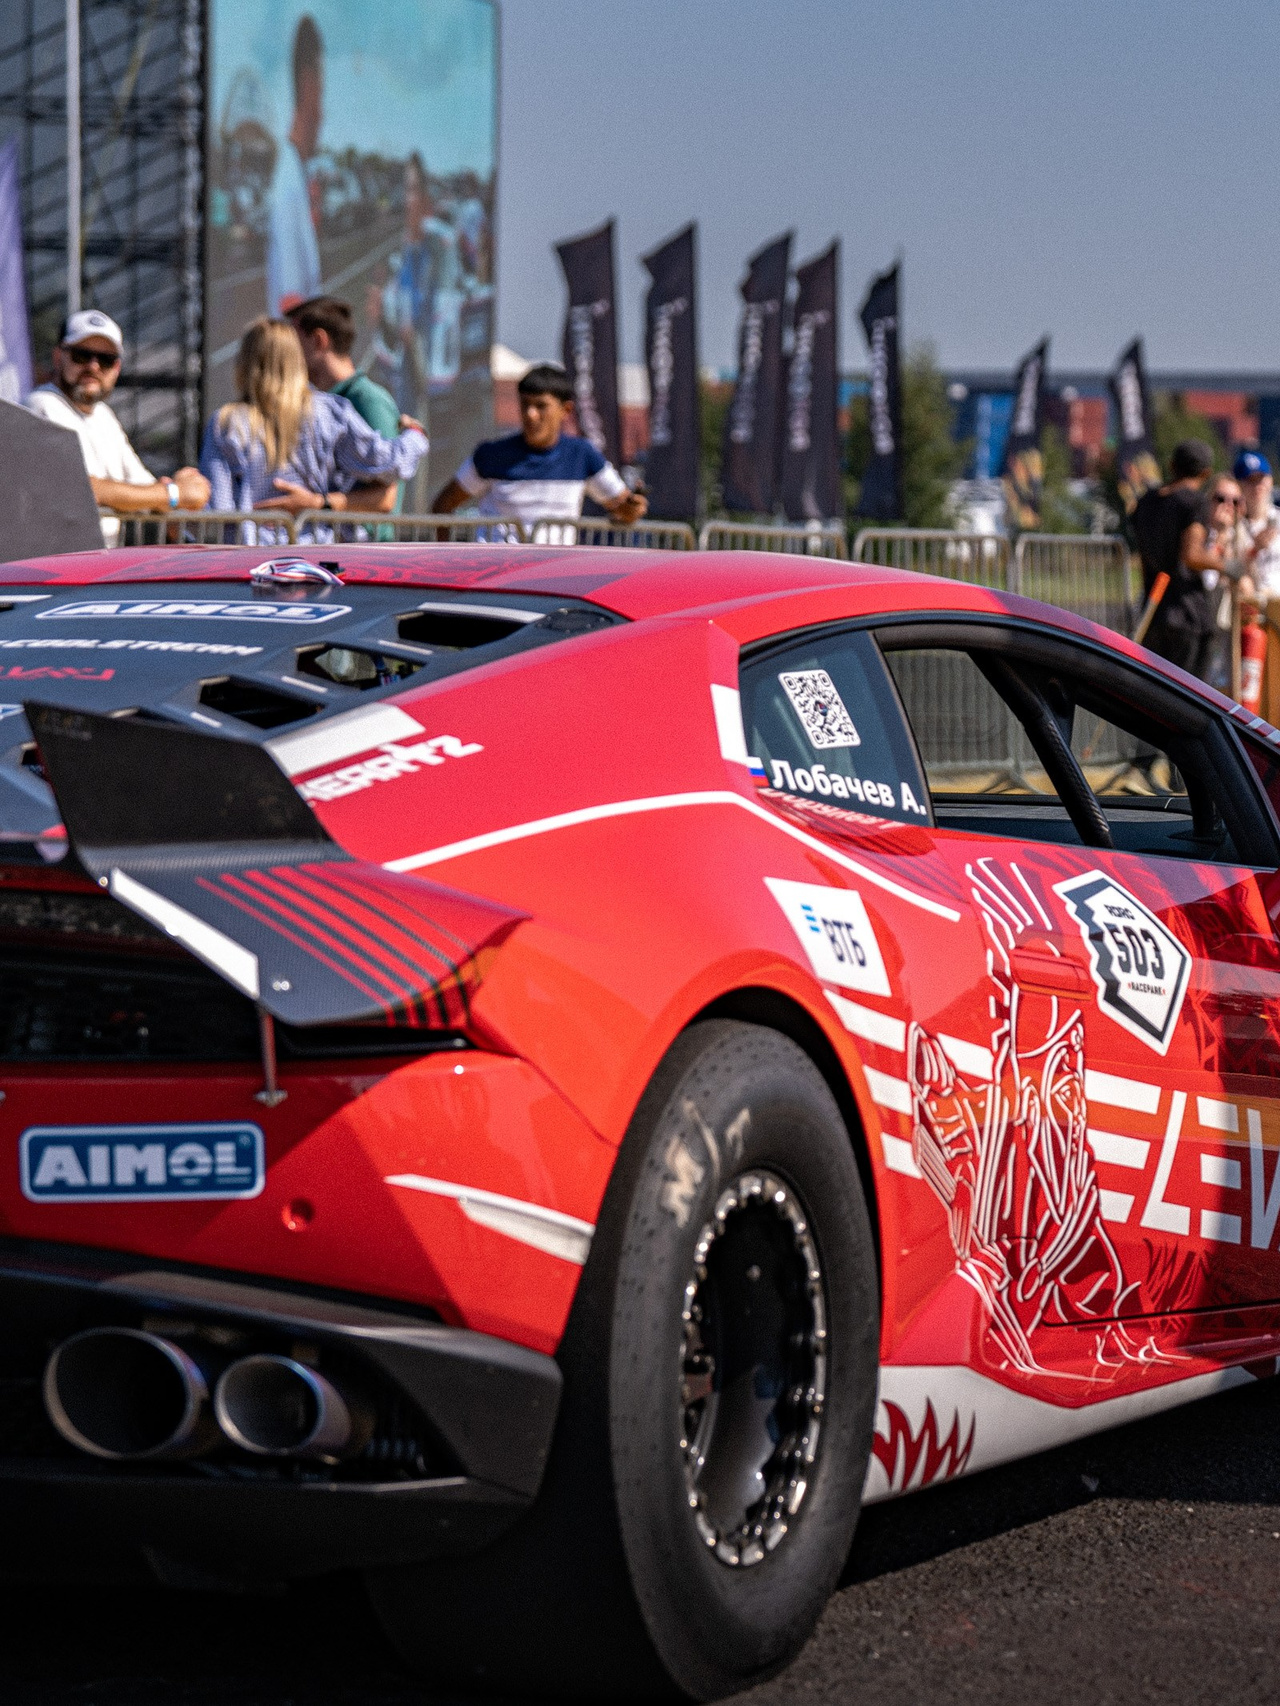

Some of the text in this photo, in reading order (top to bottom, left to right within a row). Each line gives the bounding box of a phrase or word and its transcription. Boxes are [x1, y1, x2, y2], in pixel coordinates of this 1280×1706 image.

[59, 603, 318, 620] AIMOL
[770, 759, 896, 808] Лобачев
[900, 782, 928, 816] А.
[820, 917, 867, 968] ВТБ
[1103, 922, 1165, 980] 503
[1131, 981, 1162, 995] RACEPARK
[32, 1141, 252, 1187] AIMOL
